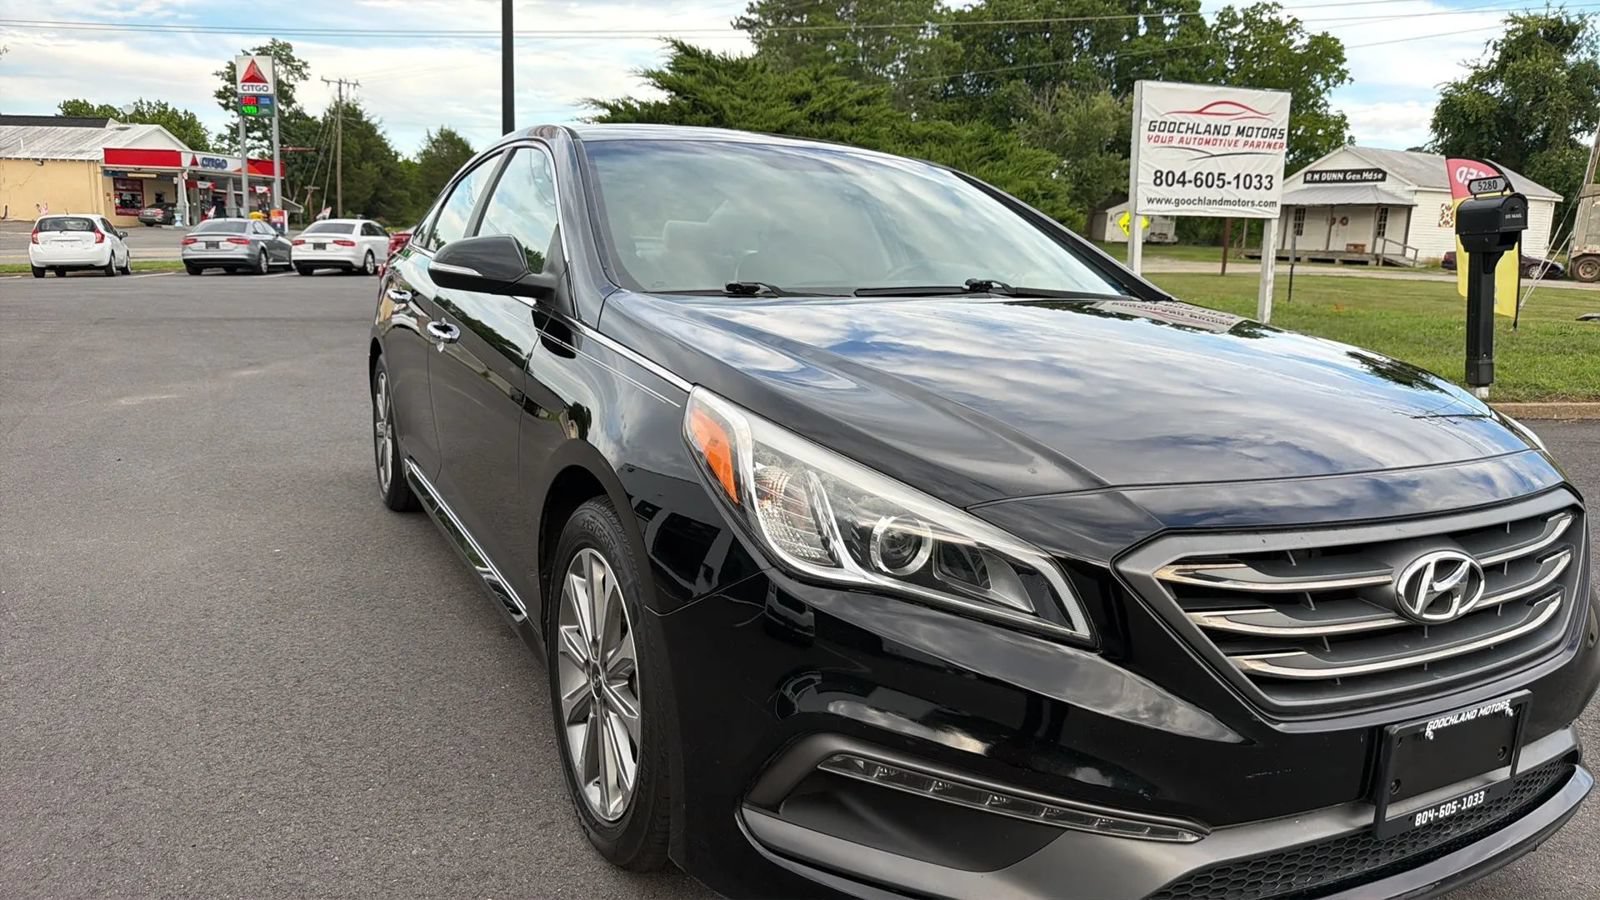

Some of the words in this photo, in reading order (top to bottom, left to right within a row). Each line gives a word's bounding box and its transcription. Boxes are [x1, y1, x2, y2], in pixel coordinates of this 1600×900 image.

[1148, 120, 1231, 137] GOOCHLAND
[1236, 126, 1286, 139] MOTORS
[1147, 135, 1174, 144] YOUR
[1178, 137, 1239, 148] AUTOMOTIVE
[1243, 141, 1286, 150] PARTNER
[201, 157, 228, 169] CITGO
[1153, 170, 1274, 191] 804-605-1033
[1321, 172, 1344, 181] DUNN
[1478, 180, 1498, 191] 5280
[1146, 196, 1277, 208] www.goochlandmotors.com
[1426, 709, 1478, 732] GOOCHLAND
[1478, 699, 1511, 717] MOTORS
[1415, 791, 1485, 826] 804-605-1033
